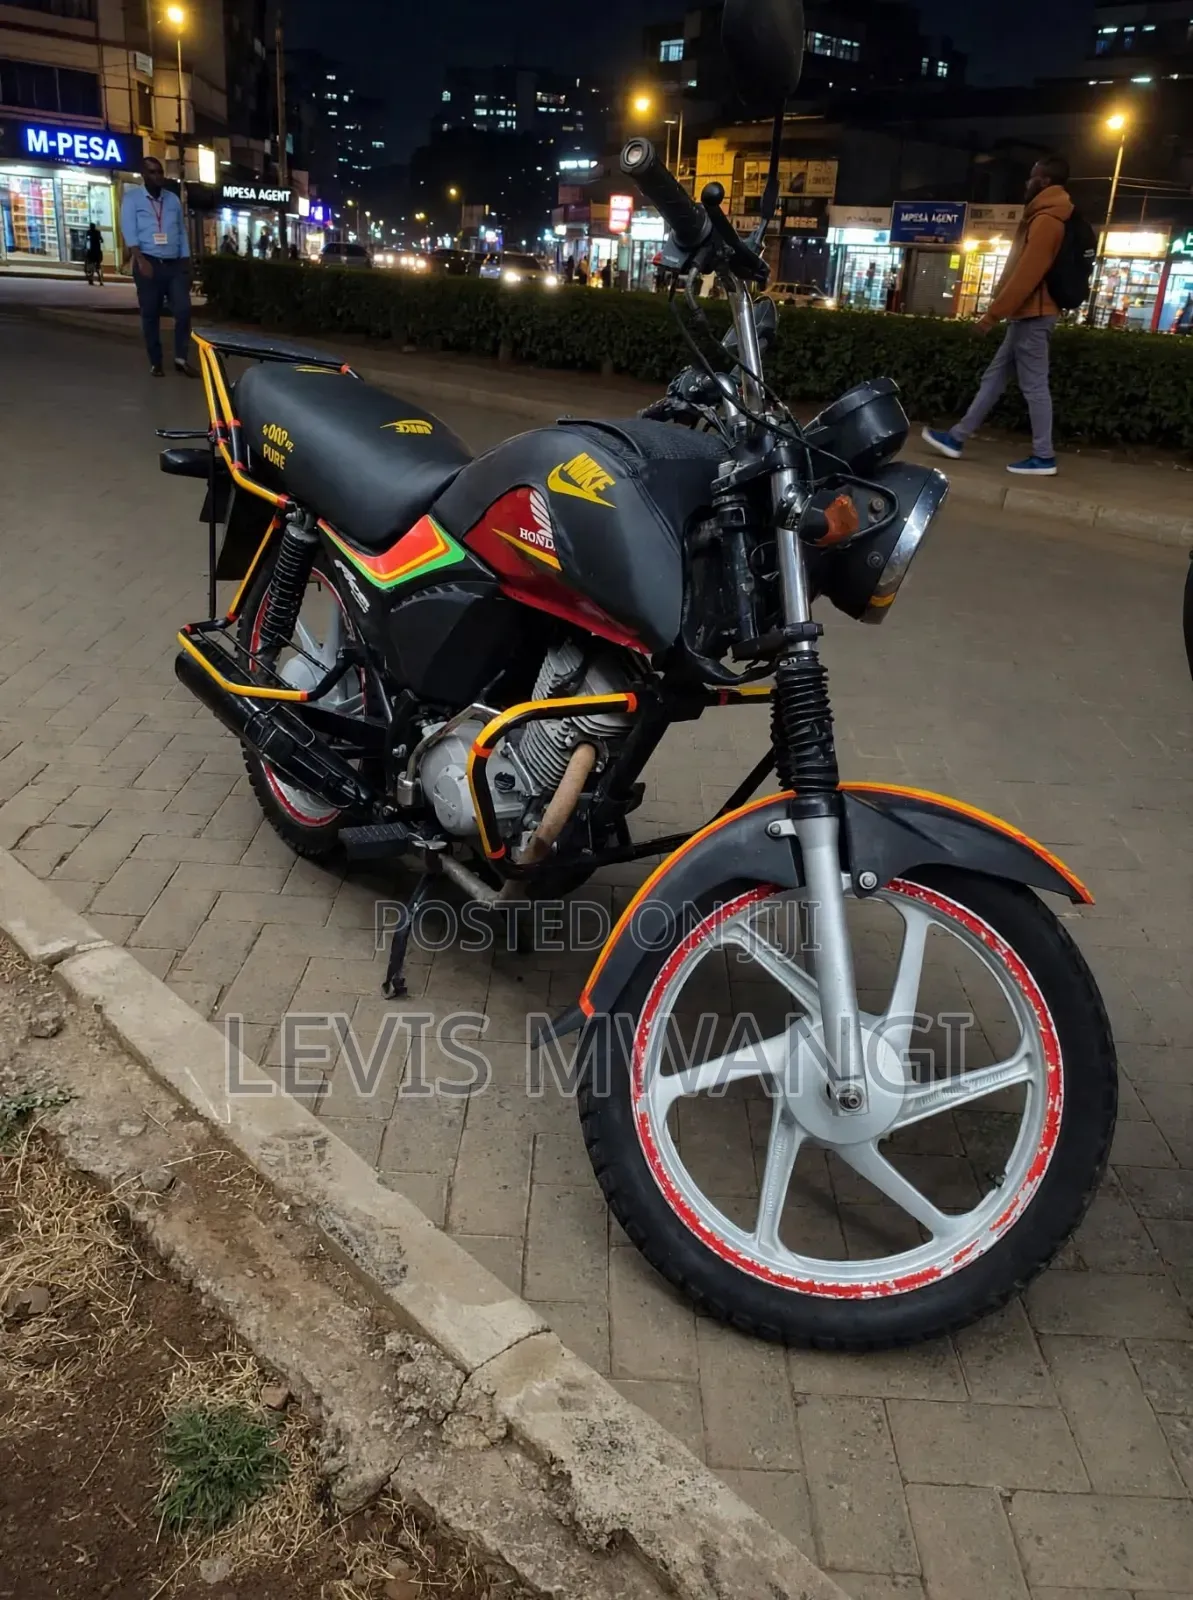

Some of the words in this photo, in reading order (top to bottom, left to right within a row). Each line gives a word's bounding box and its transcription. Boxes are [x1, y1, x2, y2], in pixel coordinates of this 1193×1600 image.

[27, 128, 122, 162] M-PESA
[223, 186, 256, 199] MPESA
[258, 189, 291, 202] AGENT
[931, 213, 959, 223] AGENT
[263, 443, 286, 470] PURE
[519, 527, 556, 551] HOND
